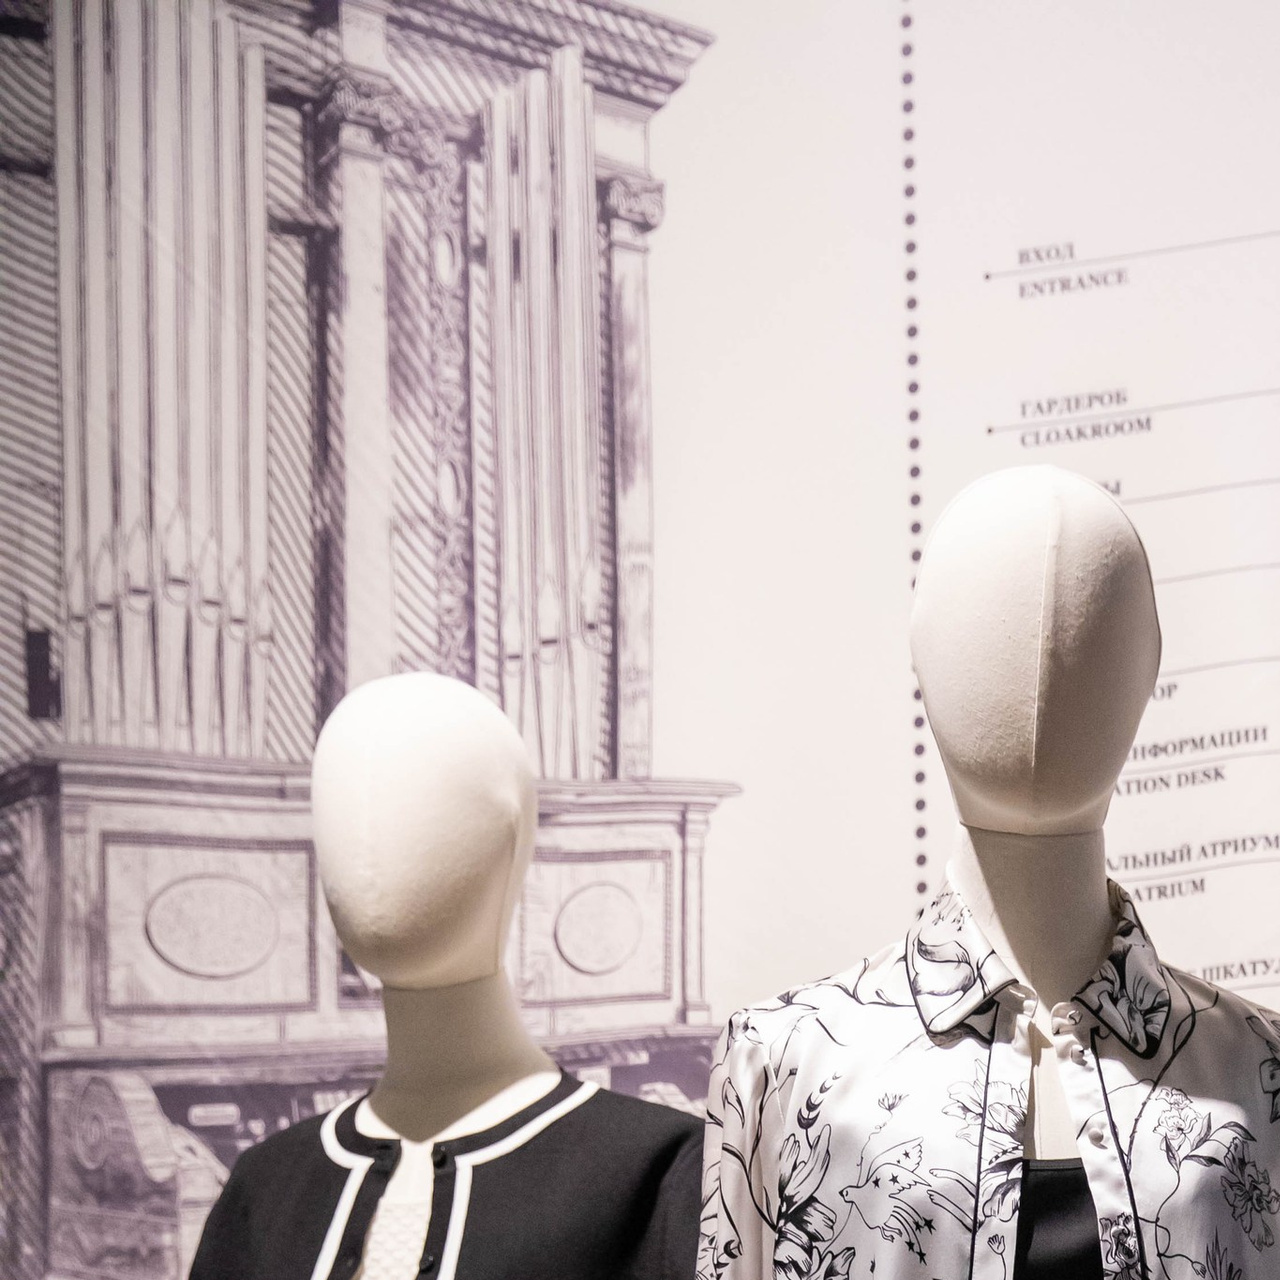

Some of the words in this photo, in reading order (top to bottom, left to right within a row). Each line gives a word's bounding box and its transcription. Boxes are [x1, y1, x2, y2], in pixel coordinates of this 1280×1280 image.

[1018, 243, 1076, 266] ВХОД
[1018, 268, 1129, 299] ENTRANCE
[1020, 388, 1128, 418] ГАРДЕРОБ
[1020, 416, 1152, 448] CLOAKROOM
[1127, 725, 1269, 762] НФОРМАЦИИ
[1176, 765, 1227, 789] DESK
[1198, 834, 1280, 862] АТРИУМ
[1132, 878, 1207, 903] ATRIUM
